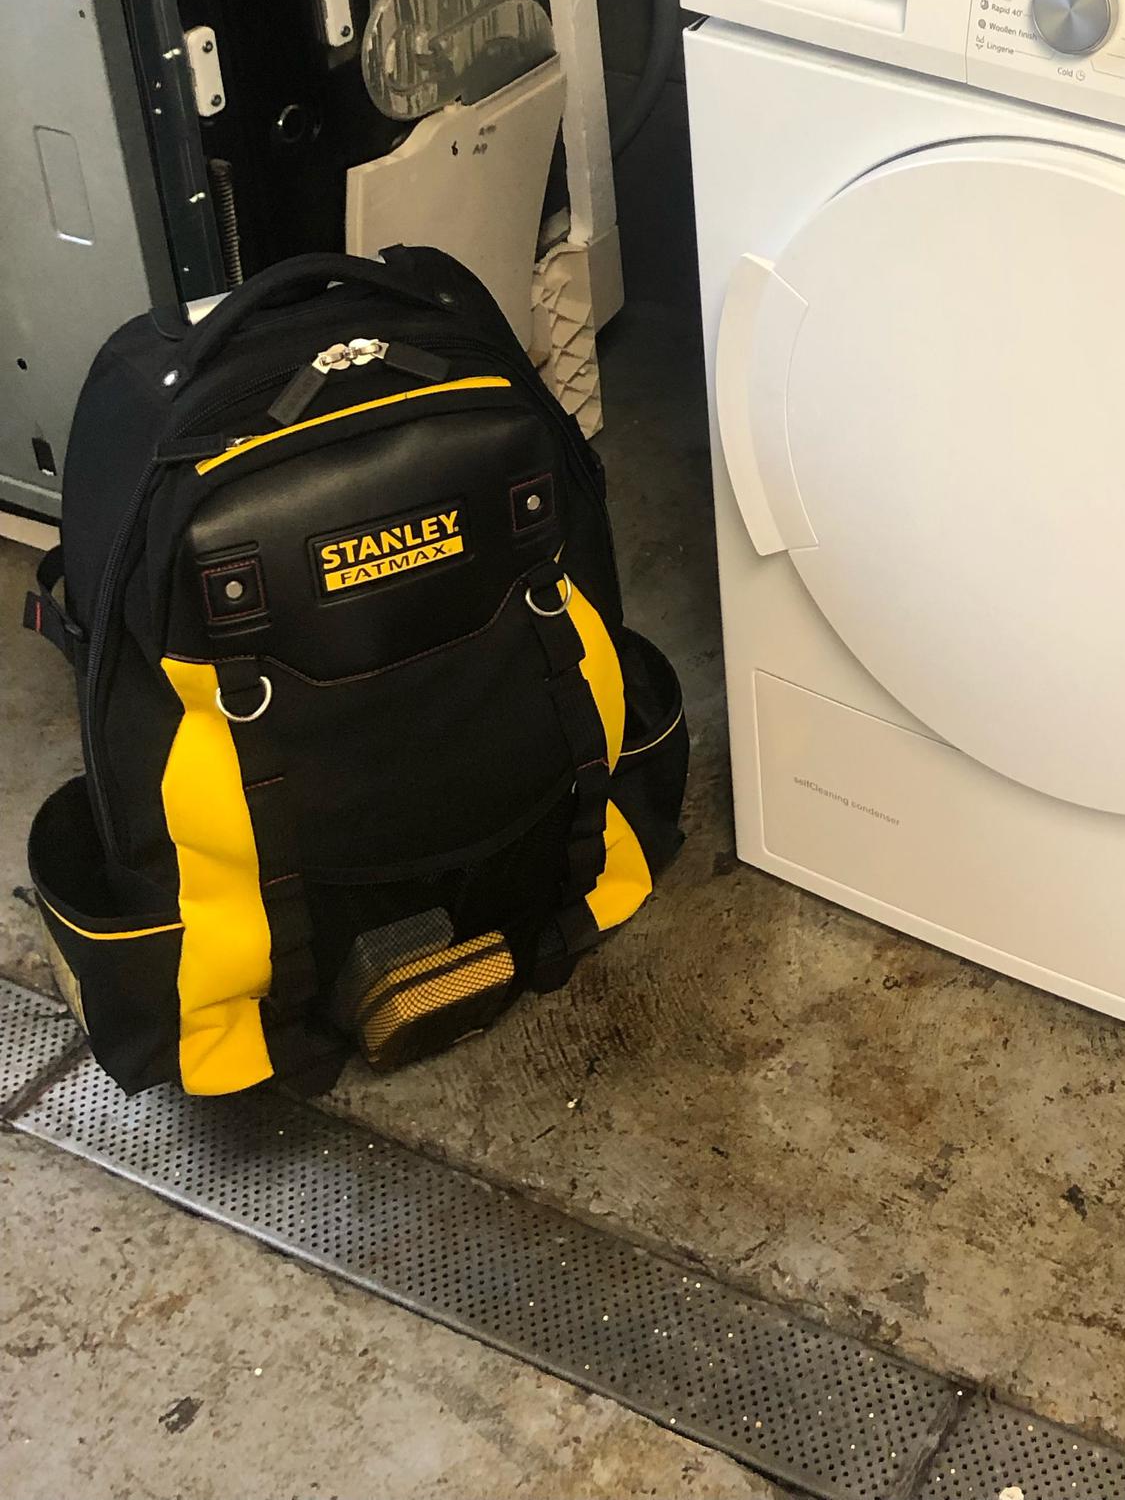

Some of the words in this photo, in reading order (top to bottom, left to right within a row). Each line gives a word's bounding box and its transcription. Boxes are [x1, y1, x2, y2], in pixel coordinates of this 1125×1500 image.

[992, 3, 1011, 17] Rapid
[989, 22, 1017, 36] Woollen
[986, 41, 1014, 55] Lingerie
[1057, 67, 1073, 78] Cold
[320, 510, 459, 571] STANLEY
[340, 543, 447, 585] FATMAX
[794, 775, 850, 807] selfCleaning
[851, 800, 901, 826] condenser
